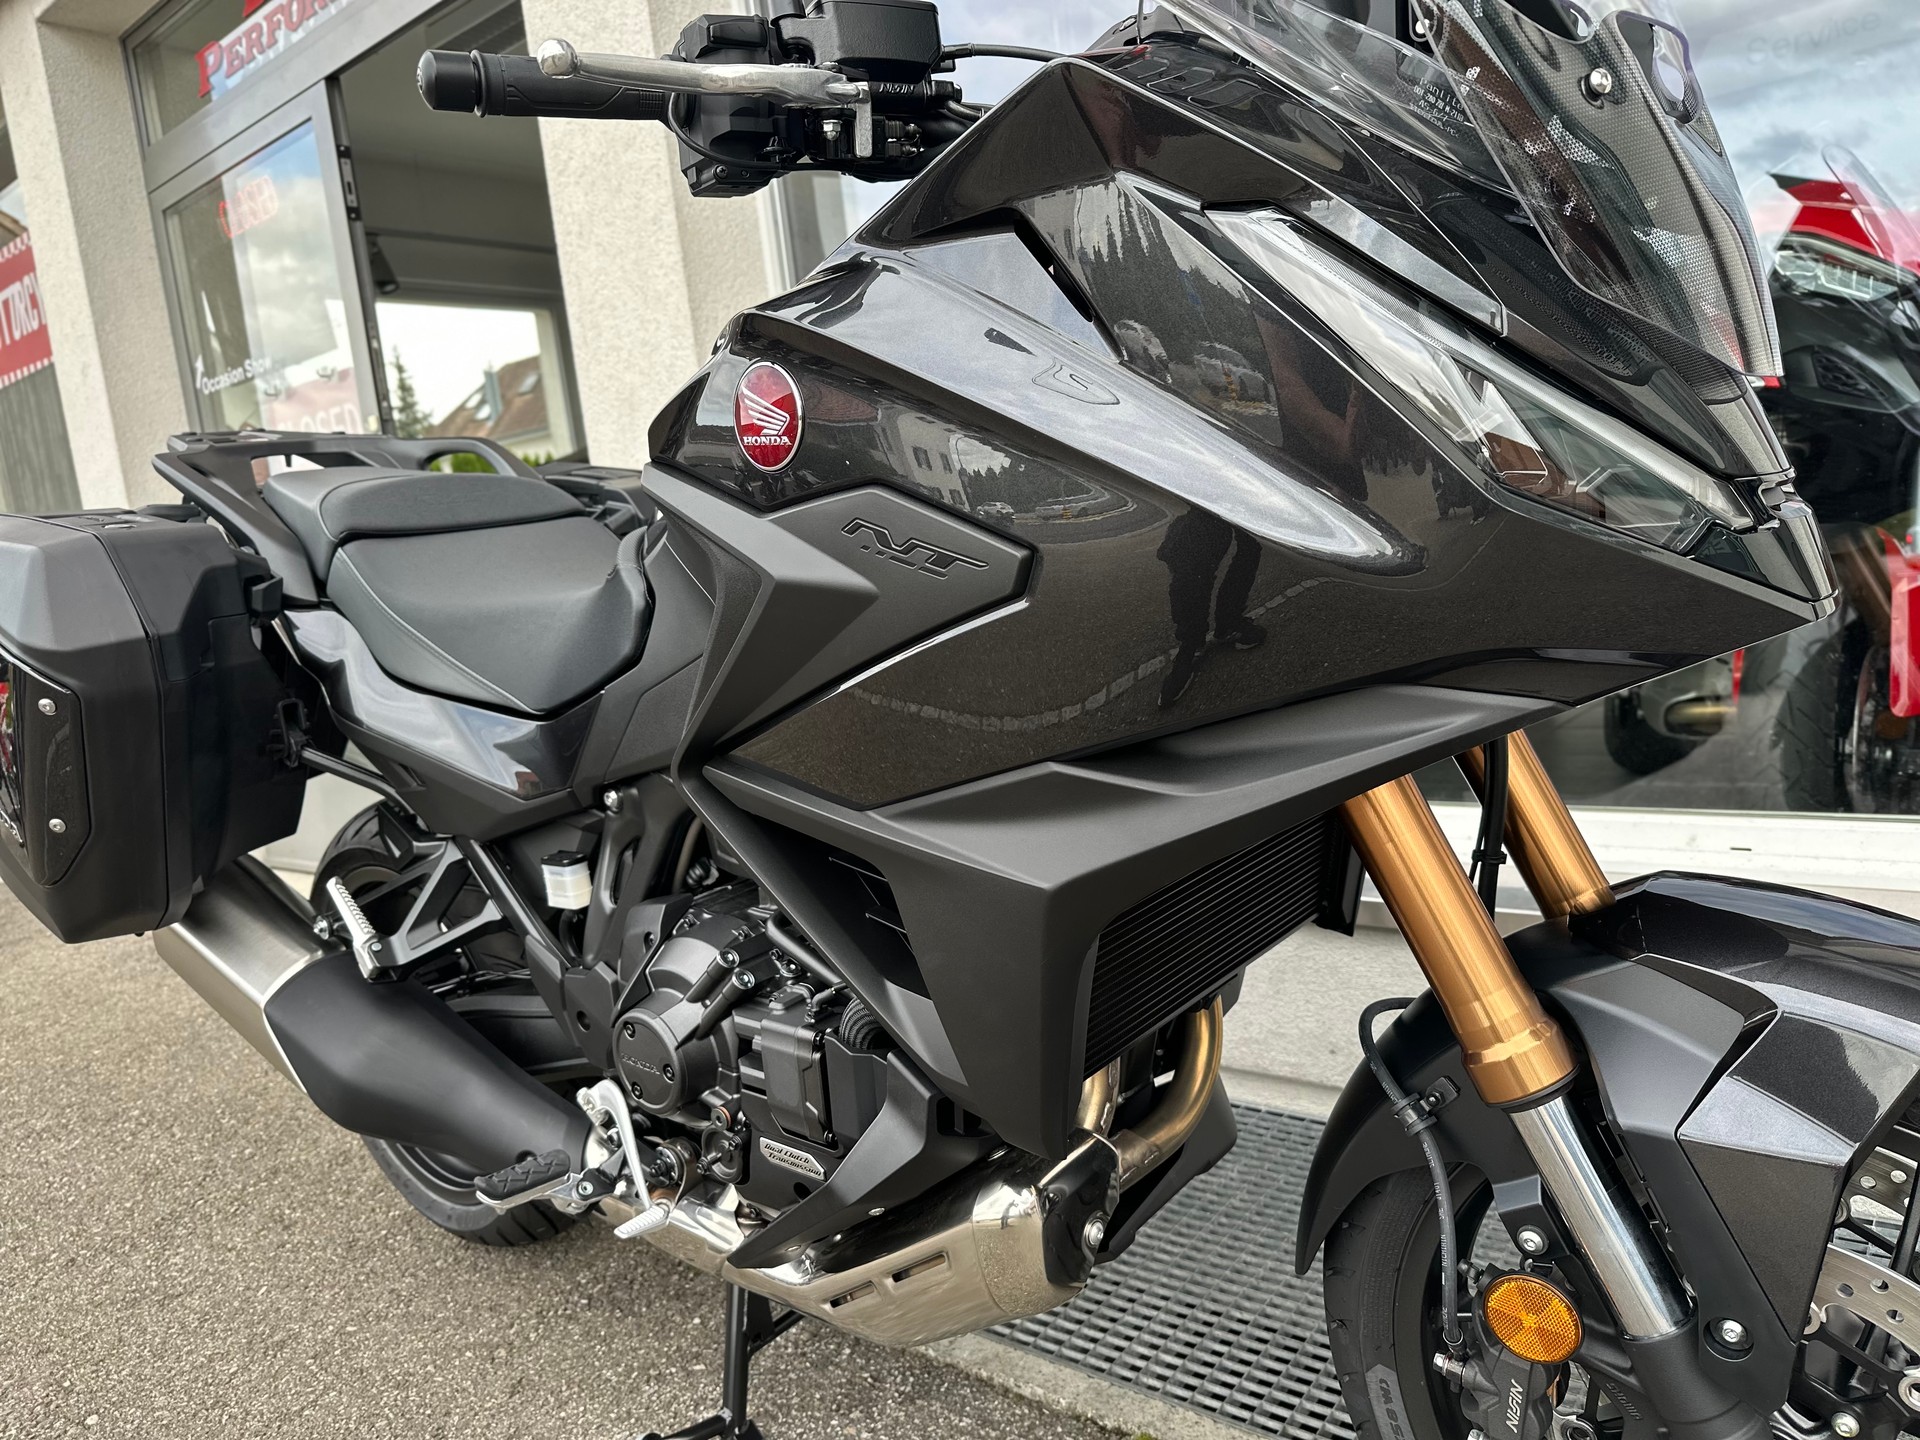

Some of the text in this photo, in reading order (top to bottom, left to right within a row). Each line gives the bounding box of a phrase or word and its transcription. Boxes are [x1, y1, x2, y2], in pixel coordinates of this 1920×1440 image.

[1746, 11, 1881, 66] Service
[202, 366, 246, 395] Occasion
[742, 435, 793, 446] HONDA
[764, 1143, 810, 1164] Dual Clutch
